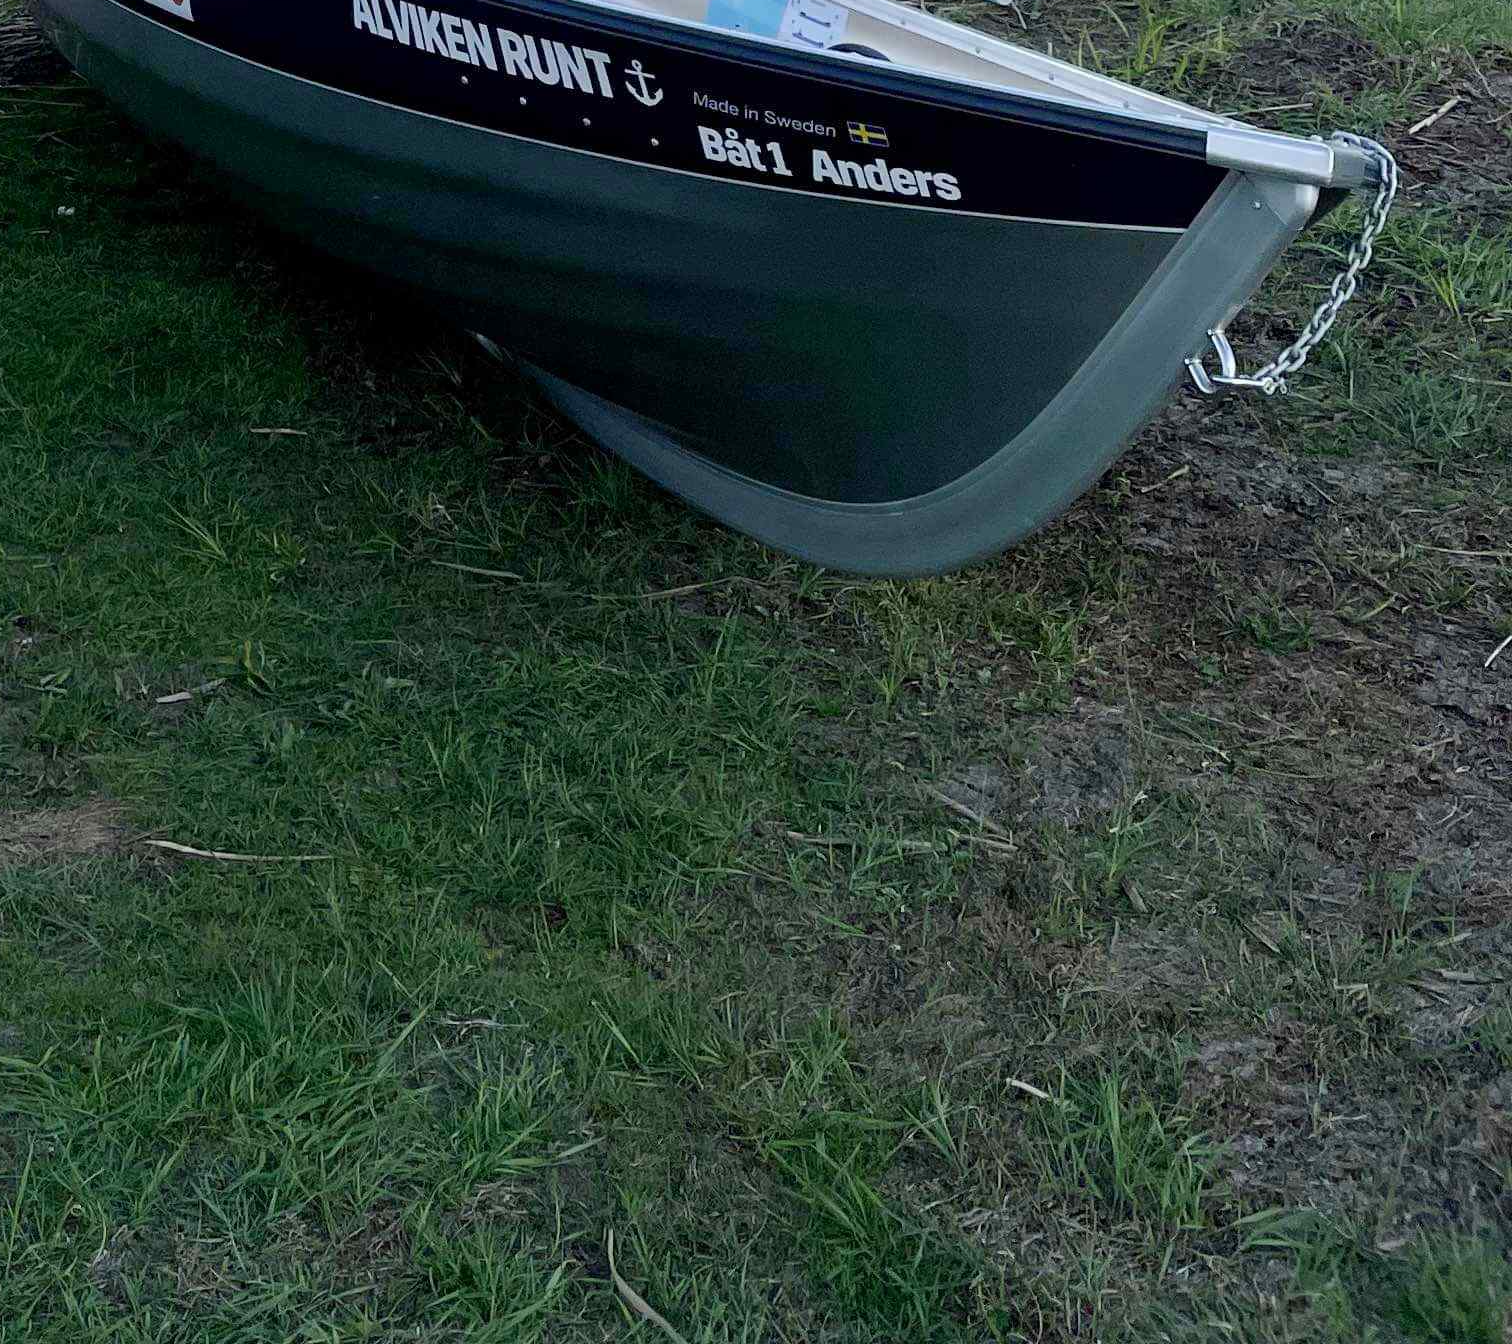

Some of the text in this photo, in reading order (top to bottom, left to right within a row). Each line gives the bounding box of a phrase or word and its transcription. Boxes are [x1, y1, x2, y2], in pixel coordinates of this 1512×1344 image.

[497, 28, 614, 98] RUNT
[693, 91, 837, 137] Made in Sweden
[813, 149, 962, 201] Anders
